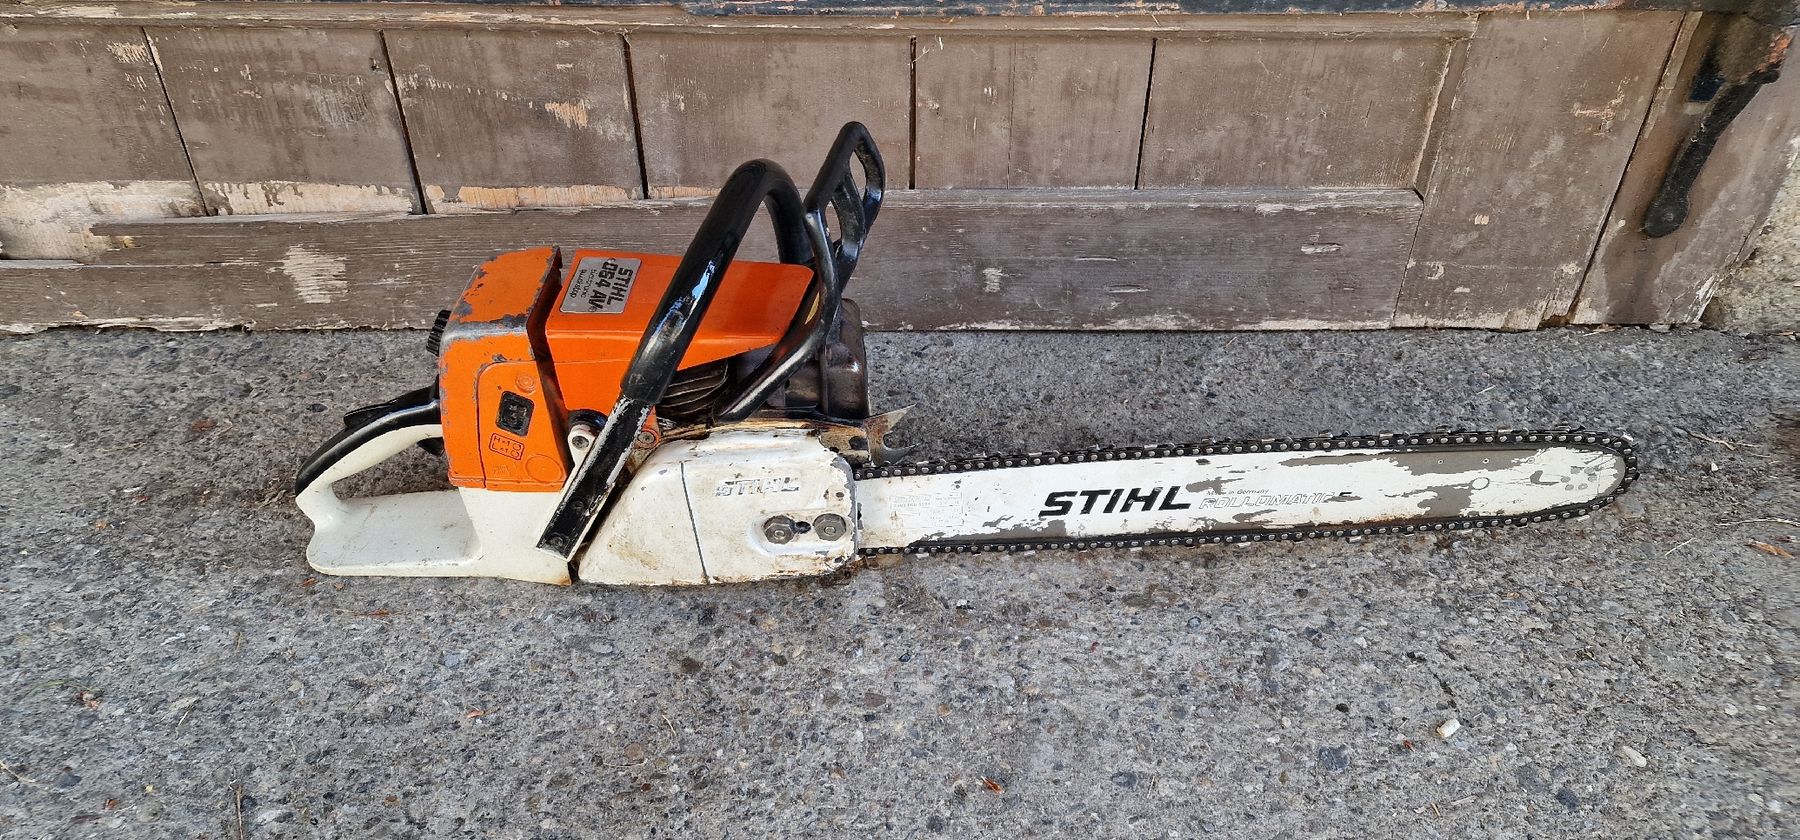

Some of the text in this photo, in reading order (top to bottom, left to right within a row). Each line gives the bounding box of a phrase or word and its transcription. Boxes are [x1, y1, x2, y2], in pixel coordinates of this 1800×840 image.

[588, 261, 618, 310] 064 AV
[606, 267, 634, 305] STIHL
[1038, 485, 1192, 518] STIHL
[1236, 488, 1269, 496] Germany
